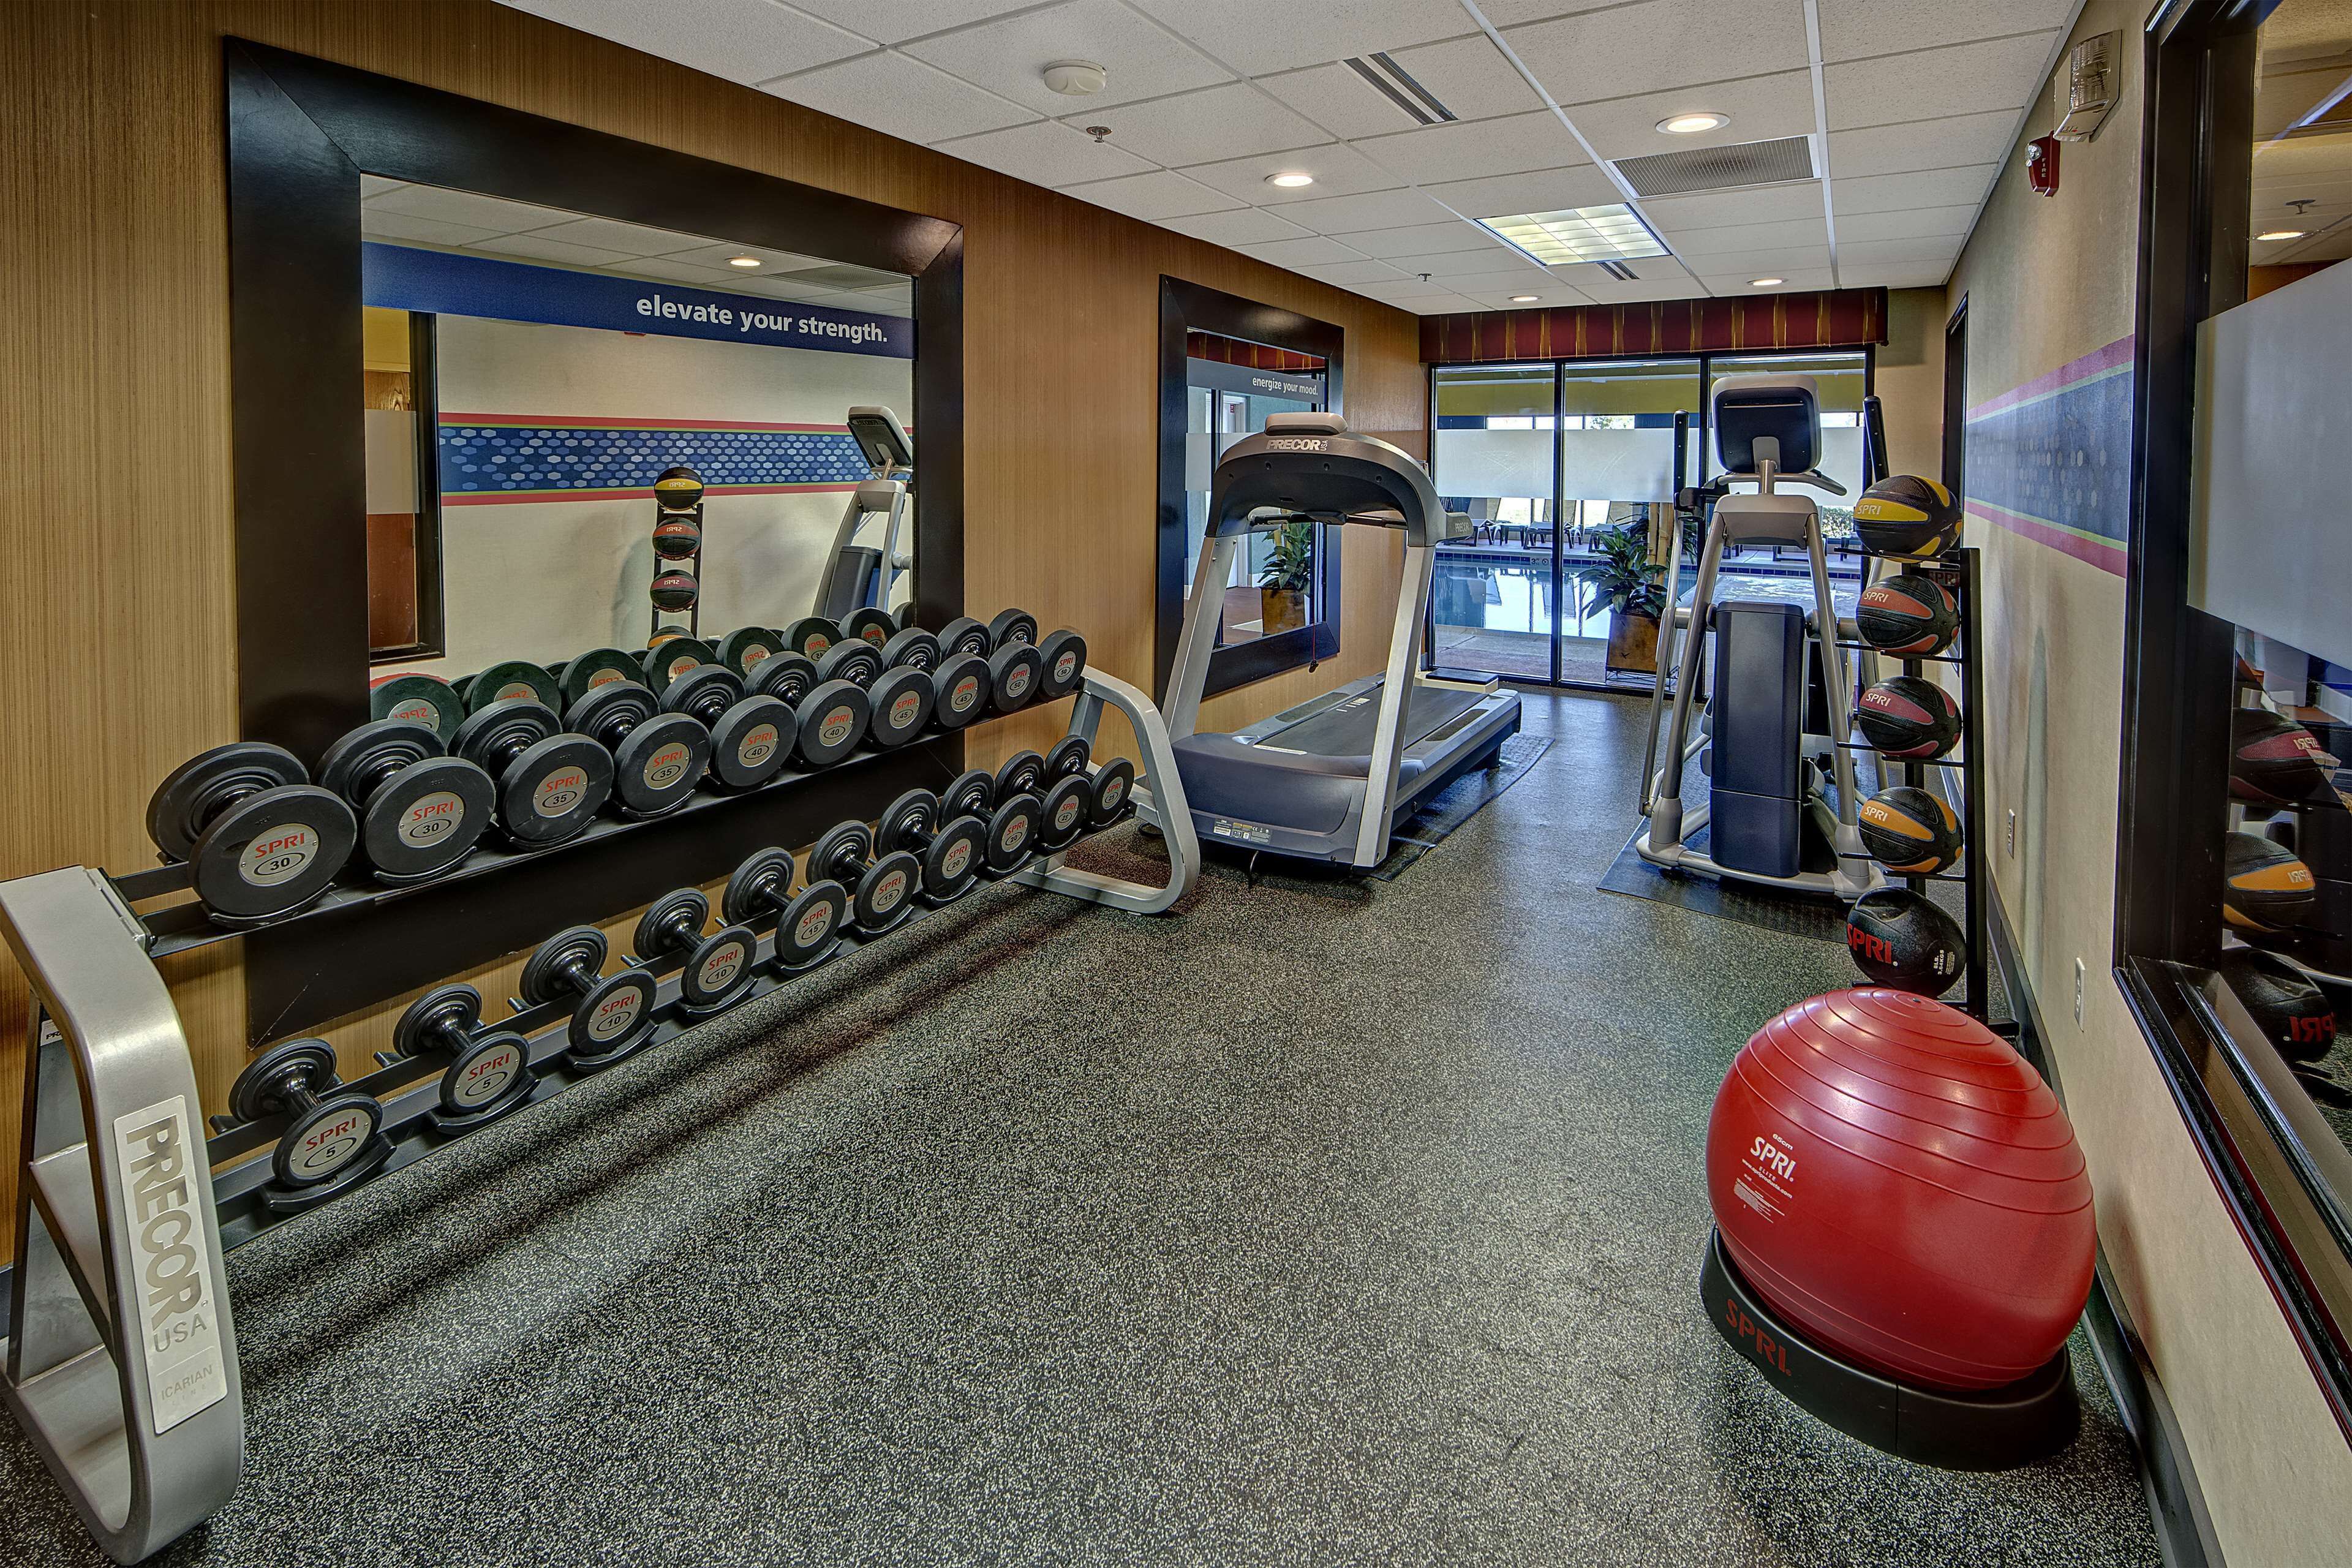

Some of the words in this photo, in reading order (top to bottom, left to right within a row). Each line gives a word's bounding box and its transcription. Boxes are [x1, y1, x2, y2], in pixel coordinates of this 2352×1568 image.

[636, 294, 733, 325] elevate
[740, 311, 792, 332] your
[799, 317, 888, 344] strength.
[1253, 377, 1282, 391] energize
[1283, 382, 1298, 393] your
[1299, 385, 1318, 395] mood.
[1266, 439, 1321, 450] PRECOR
[1320, 440, 1329, 451] USA
[1857, 505, 1882, 515] SPRI
[1864, 592, 1889, 603] SPRI
[1059, 657, 1074, 667] SPRI
[1011, 669, 1027, 680] SPRI
[957, 683, 974, 694] SPRI
[896, 697, 916, 710] SPRI
[1866, 693, 1891, 706] SPRI
[827, 714, 849, 726] SPRI
[747, 732, 772, 745] SPRI
[652, 750, 683, 767] SPRI
[660, 769, 672, 778] 35
[545, 775, 580, 793] SPRI
[1107, 782, 1121, 793] SPRI
[553, 794, 567, 804] 35
[412, 801, 454, 821] SPRI
[1061, 802, 1077, 812] SPRI
[1864, 806, 1888, 821] SPRI
[423, 823, 439, 834] 30
[1007, 820, 1024, 835] SPRI
[255, 832, 304, 859] SPRI
[948, 844, 967, 861] SPRI
[270, 858, 290, 870] 30
[951, 859, 960, 868] 20
[878, 876, 902, 895] SPRI
[884, 892, 893, 902] 15
[803, 906, 827, 928] SPRI
[809, 925, 819, 935] 15
[708, 949, 737, 970] SPRI
[715, 969, 726, 979] 10
[600, 993, 636, 1017] SPRI
[608, 1016, 621, 1027] 10
[467, 1052, 510, 1081] SPRI
[483, 1078, 491, 1088] 5
[306, 1117, 356, 1152] SPRI
[326, 1146, 336, 1158] 5
[126, 1114, 202, 1332] PRECOR
[154, 1313, 207, 1352] USA
[161, 1365, 213, 1400] ICARIAN
